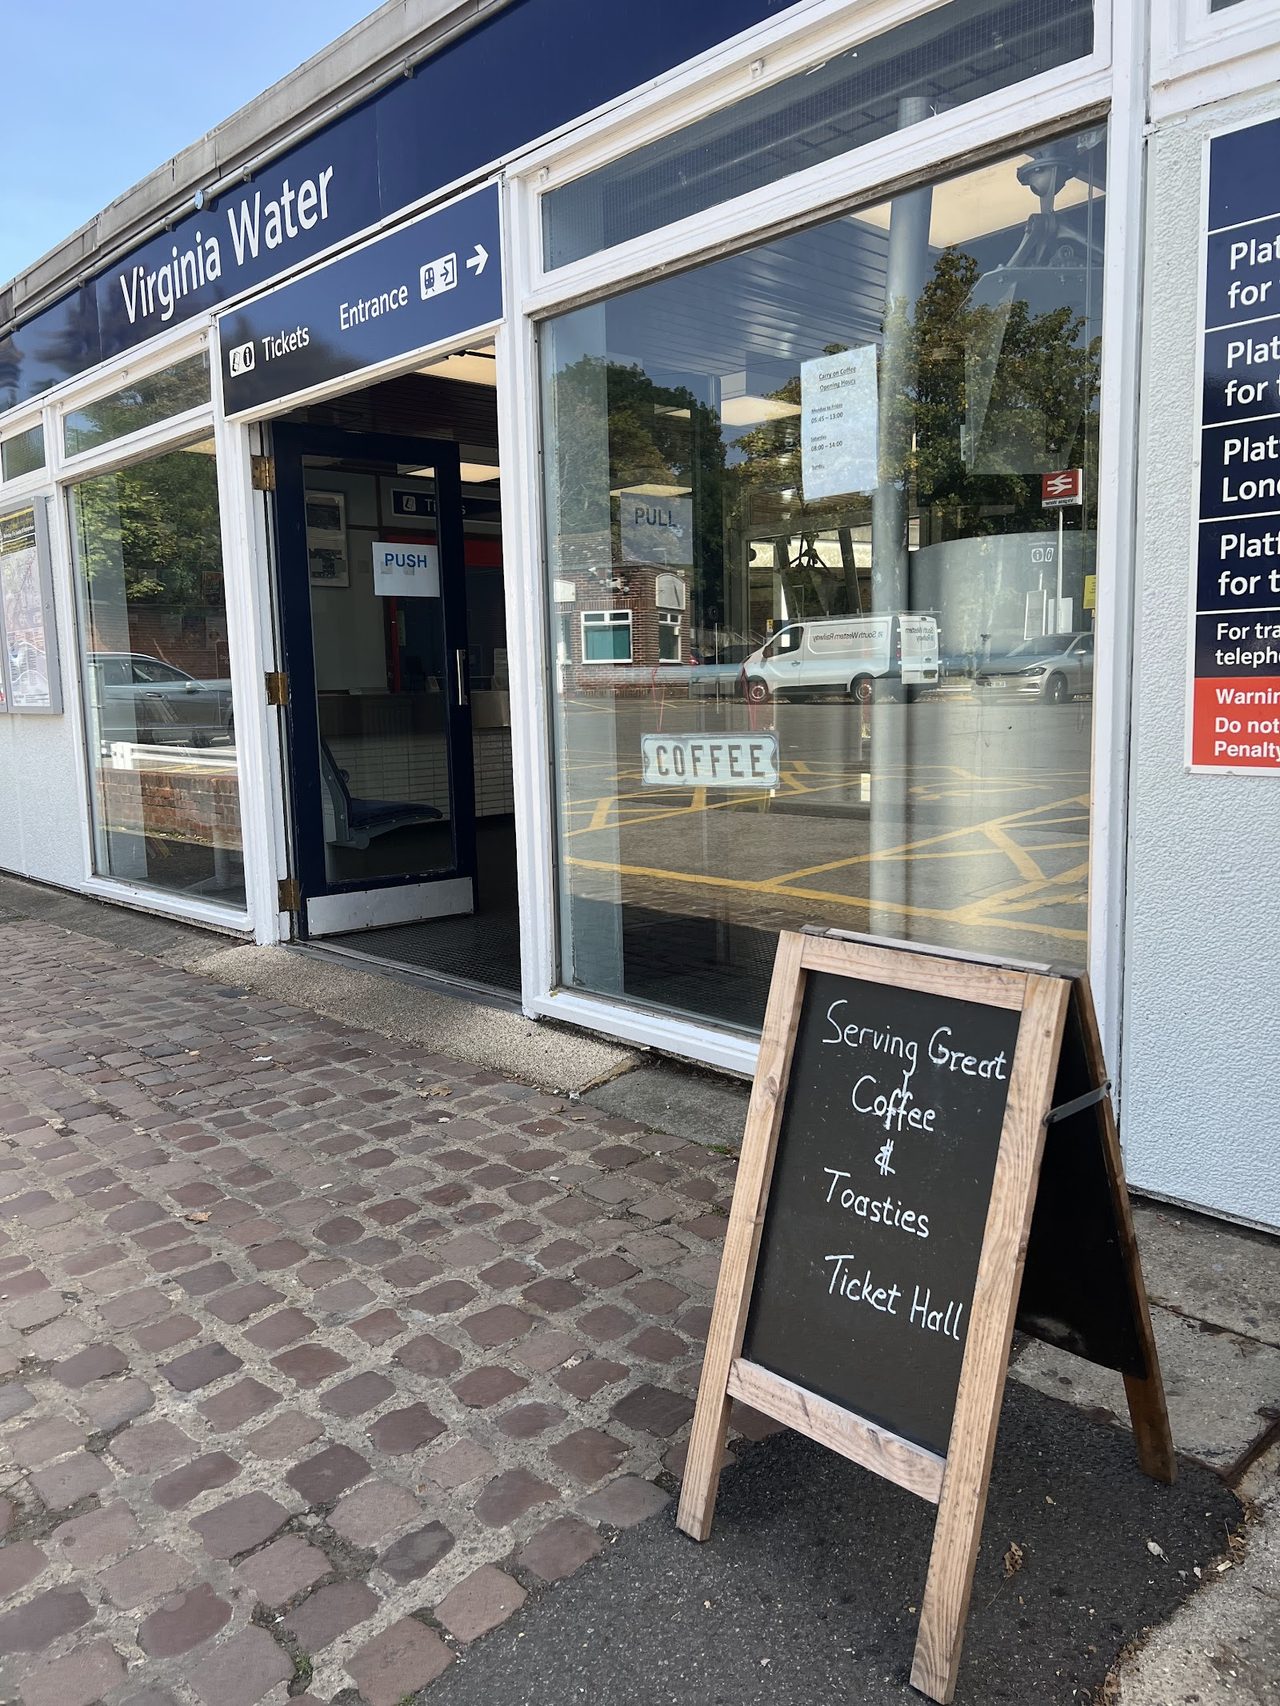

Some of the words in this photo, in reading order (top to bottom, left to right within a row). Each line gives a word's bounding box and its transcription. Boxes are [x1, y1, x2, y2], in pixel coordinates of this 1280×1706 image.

[120, 231, 222, 324] Virginia
[228, 165, 334, 266] Water
[340, 285, 408, 330] Entrance
[1228, 281, 1272, 308] for
[262, 325, 310, 361] Tickets
[1225, 380, 1268, 406] for
[1223, 435, 1280, 465] Plat
[634, 507, 678, 529] PULL
[384, 552, 428, 569] PUSH
[1217, 570, 1262, 596] for
[1216, 622, 1251, 641] For
[1215, 646, 1280, 668] teleph
[1215, 717, 1242, 734] Do
[1247, 717, 1280, 734] not
[656, 743, 766, 778] COFFEE
[823, 1000, 918, 1075] Serving
[928, 1027, 1006, 1080] Great
[852, 1074, 936, 1131] Coffee
[824, 1166, 930, 1238] Toasties
[824, 1254, 902, 1315] Ticket
[909, 1285, 963, 1341] Hall
